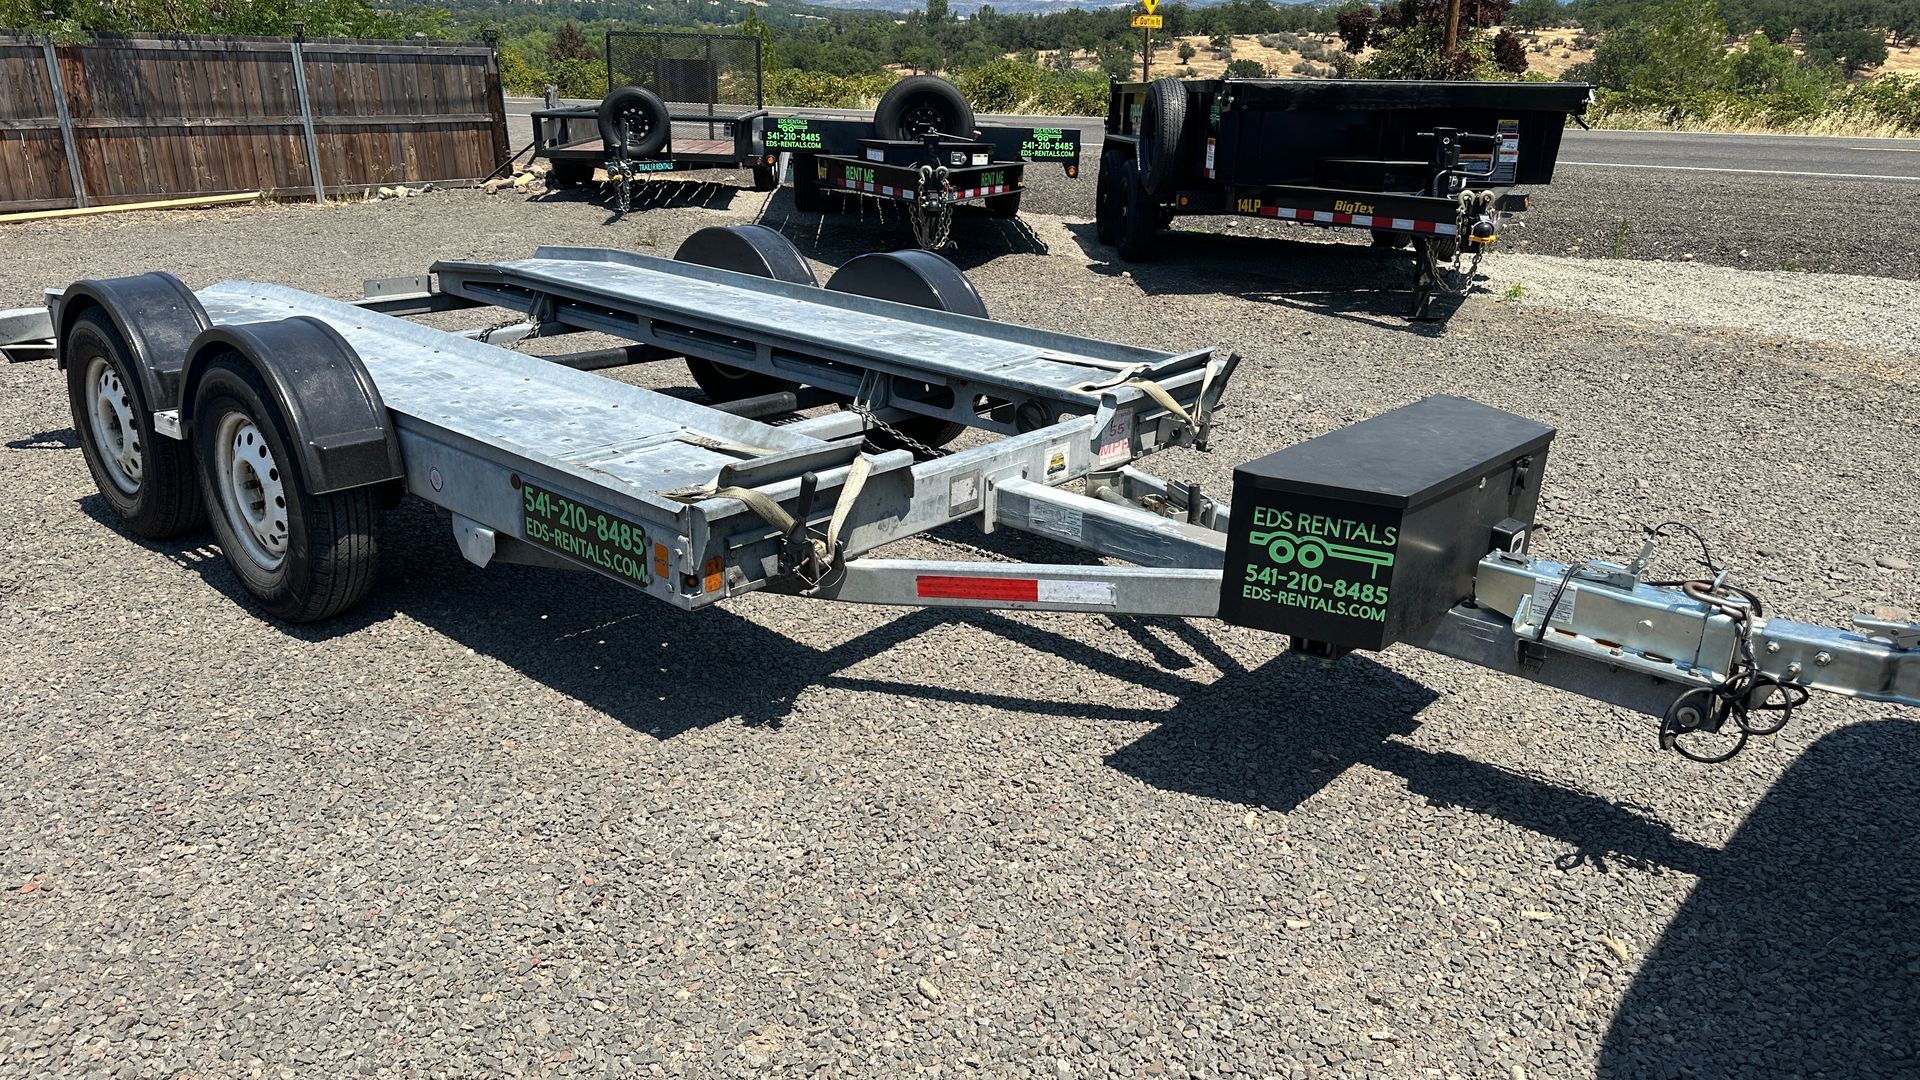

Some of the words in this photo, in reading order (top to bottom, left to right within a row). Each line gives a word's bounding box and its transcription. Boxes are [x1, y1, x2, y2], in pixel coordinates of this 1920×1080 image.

[765, 140, 822, 149] EDS-RENTALS.COM
[767, 131, 821, 142] 541-210-8485
[1020, 149, 1075, 157] EDS-RENTALS.COM
[1022, 141, 1074, 150] 541-210-8485
[845, 165, 863, 182] RENT
[863, 168, 875, 183] ME
[980, 171, 996, 187] RENT
[995, 170, 1005, 185] ME
[1237, 199, 1262, 213] 14LP
[1334, 200, 1375, 214] BigTex
[1109, 422, 1125, 437] 55
[525, 486, 645, 555] 541-210-8485
[1253, 506, 1294, 530] EDS
[1297, 512, 1397, 547] RENTALS
[525, 516, 646, 583] EDS-RENTALS.COM
[1245, 563, 1389, 605] 541-210-8485
[1242, 584, 1387, 622] EDS-RENTALS.COM
